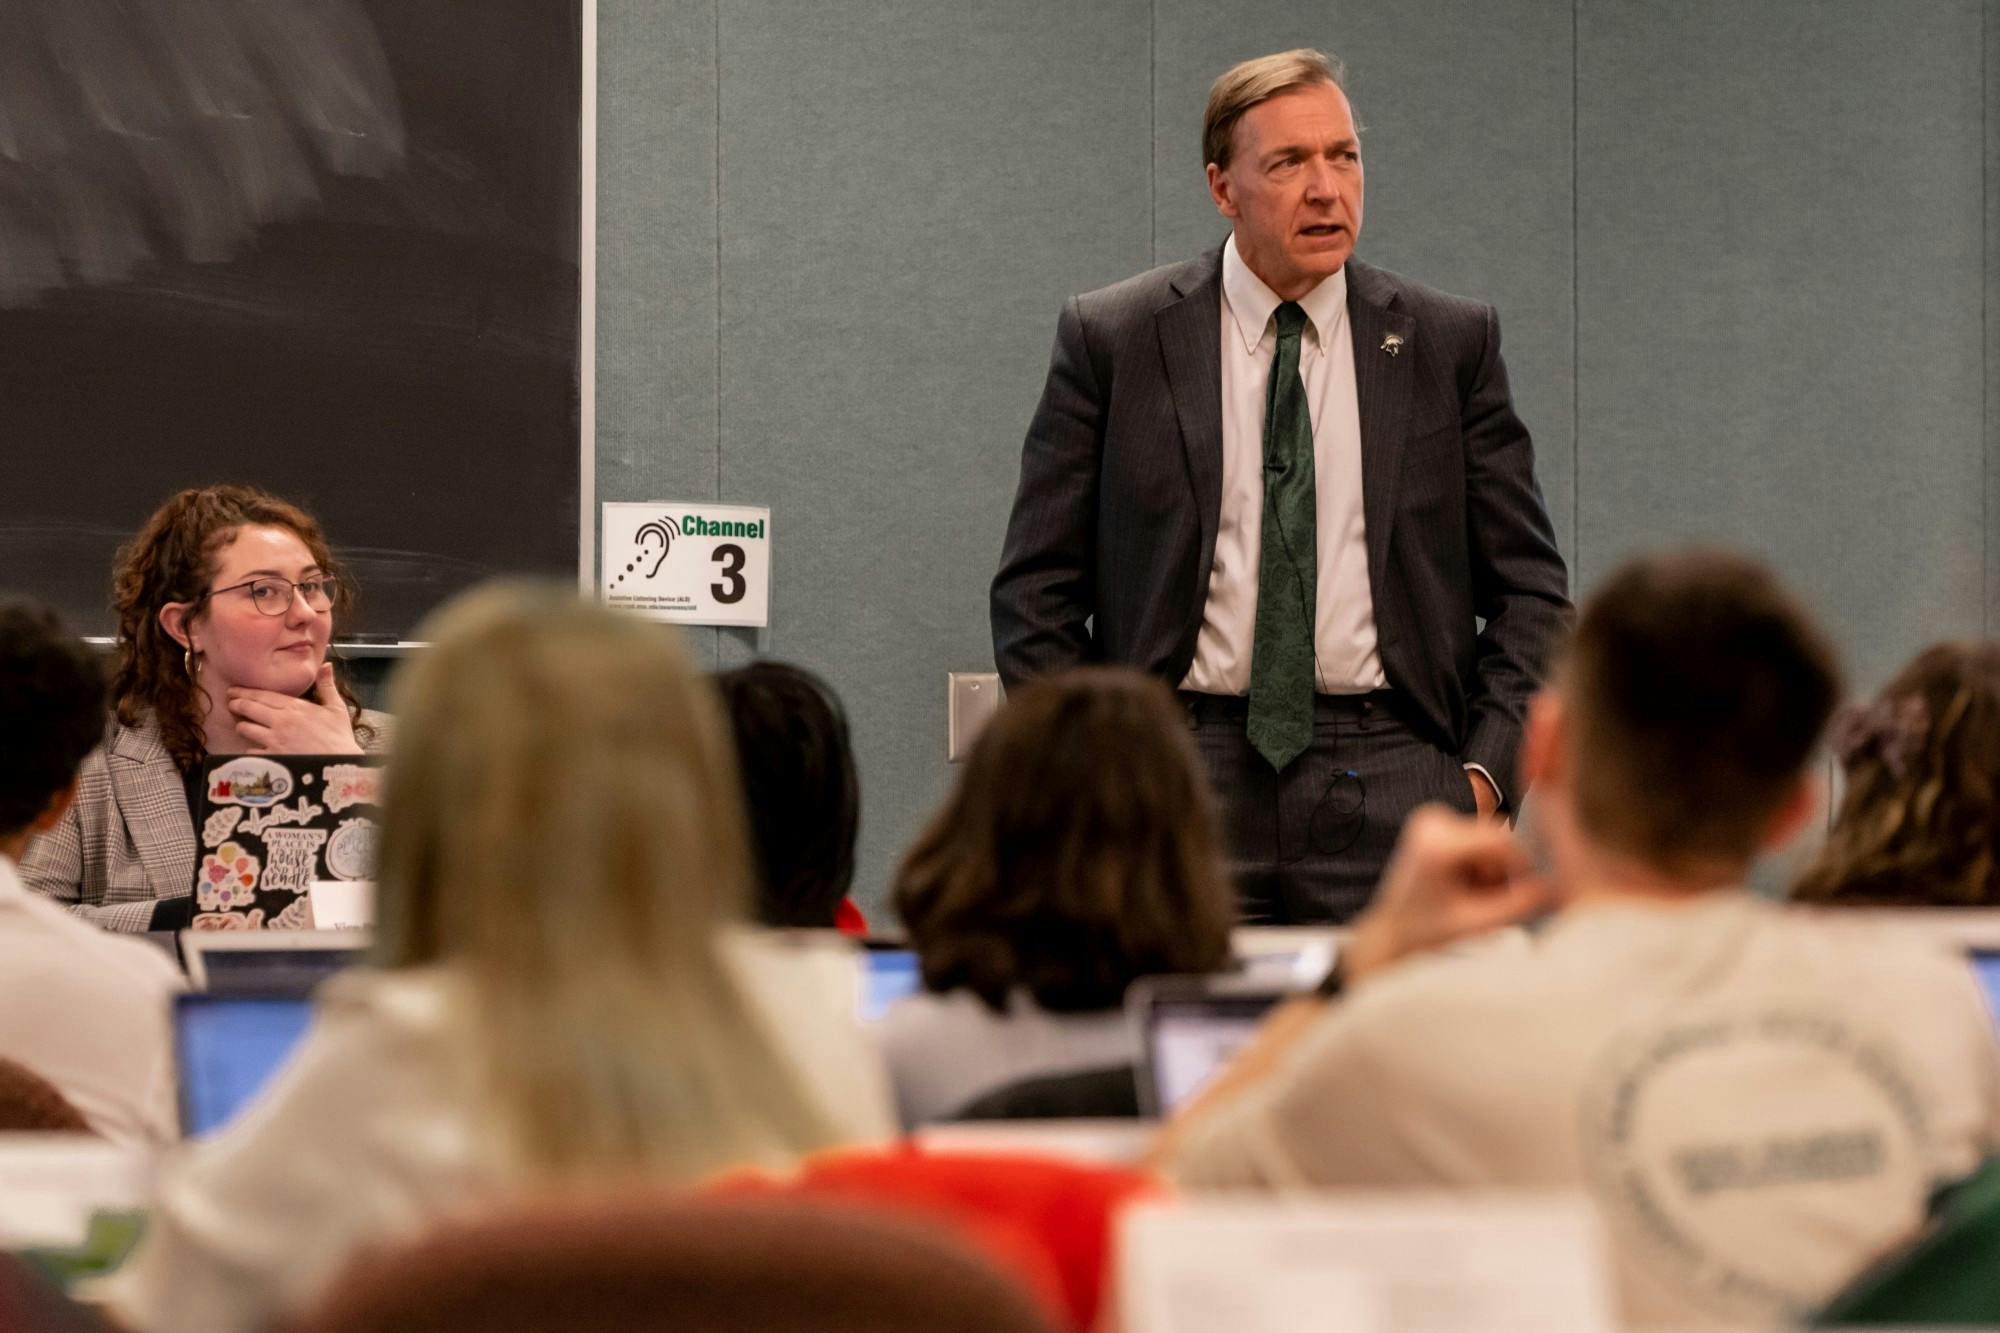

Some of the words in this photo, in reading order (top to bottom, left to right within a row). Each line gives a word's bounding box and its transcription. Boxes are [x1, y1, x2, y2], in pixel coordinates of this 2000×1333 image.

[682, 514, 765, 539] Channel
[710, 543, 747, 605] 3
[633, 595, 657, 603] Listening
[271, 840, 302, 848] PLACE
[306, 840, 315, 848] IS
[264, 873, 311, 890] senate
